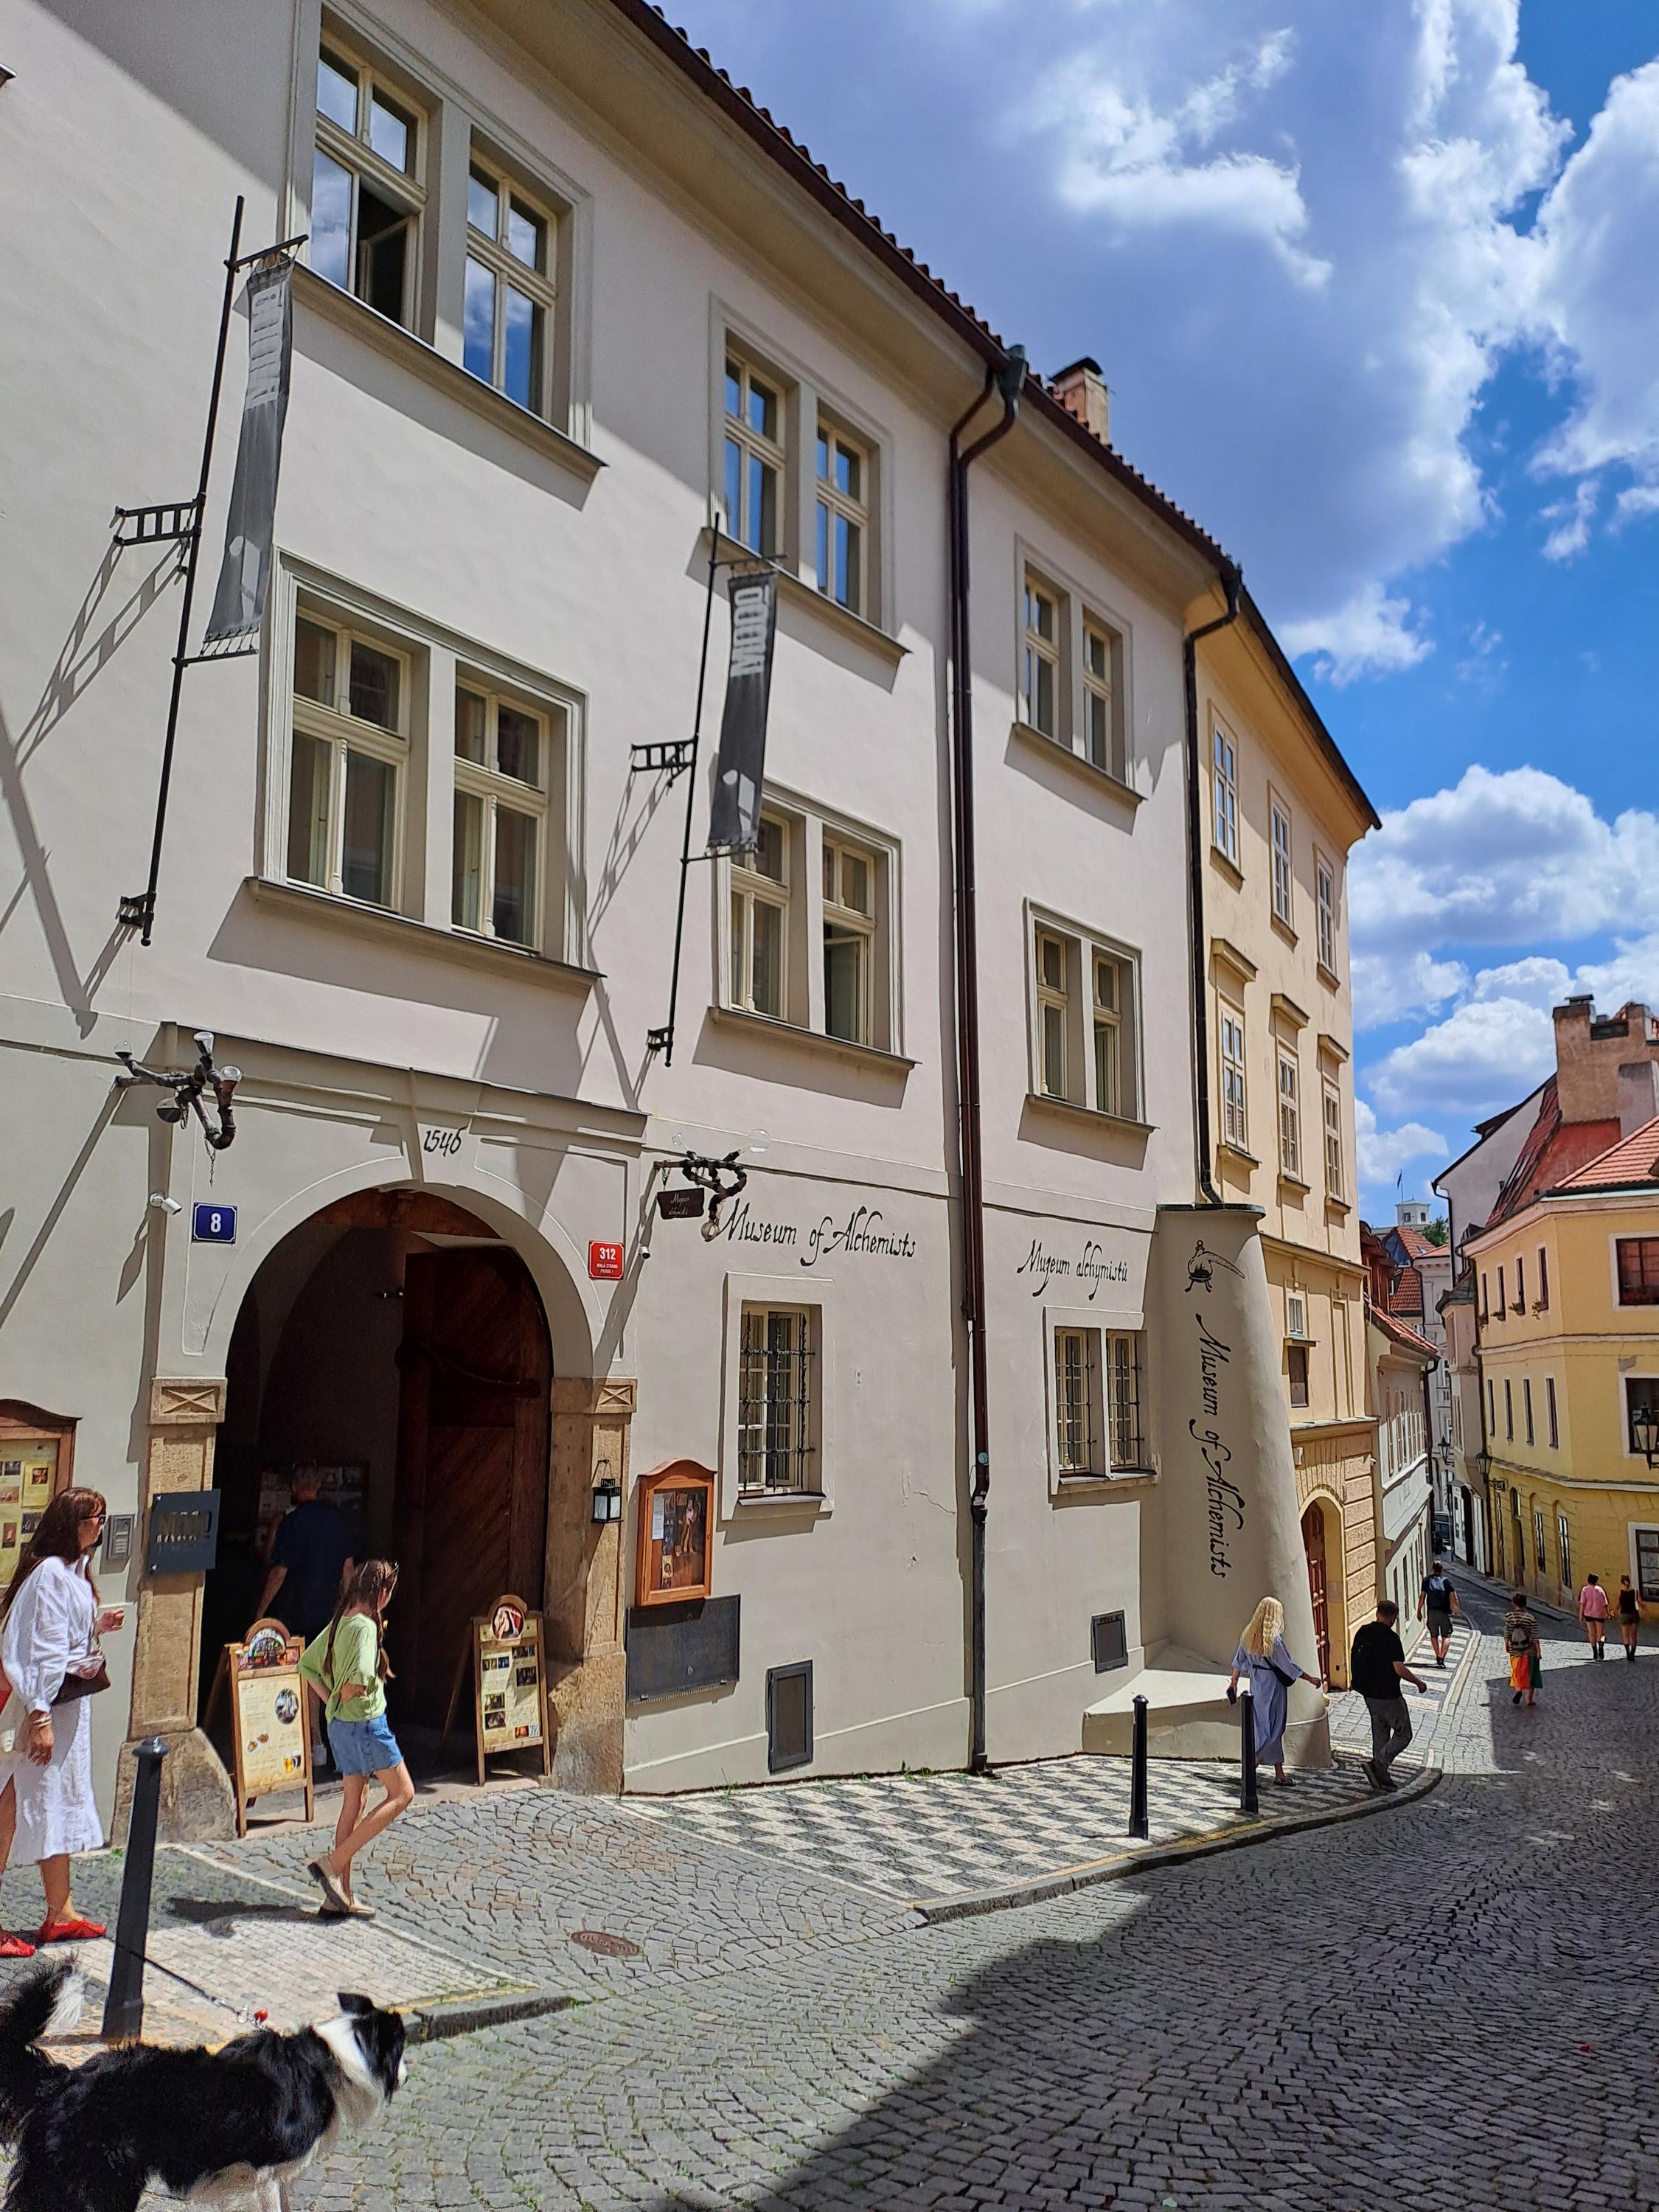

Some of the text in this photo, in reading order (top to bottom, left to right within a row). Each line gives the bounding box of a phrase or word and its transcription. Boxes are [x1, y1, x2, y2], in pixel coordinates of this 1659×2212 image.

[423, 1125, 468, 1158] 1546
[210, 1213, 221, 1233] 8
[706, 1197, 916, 1267] Museum of Alchemists
[599, 1247, 616, 1260] 312
[1189, 1313, 1245, 1578] Museum of Alchemists
